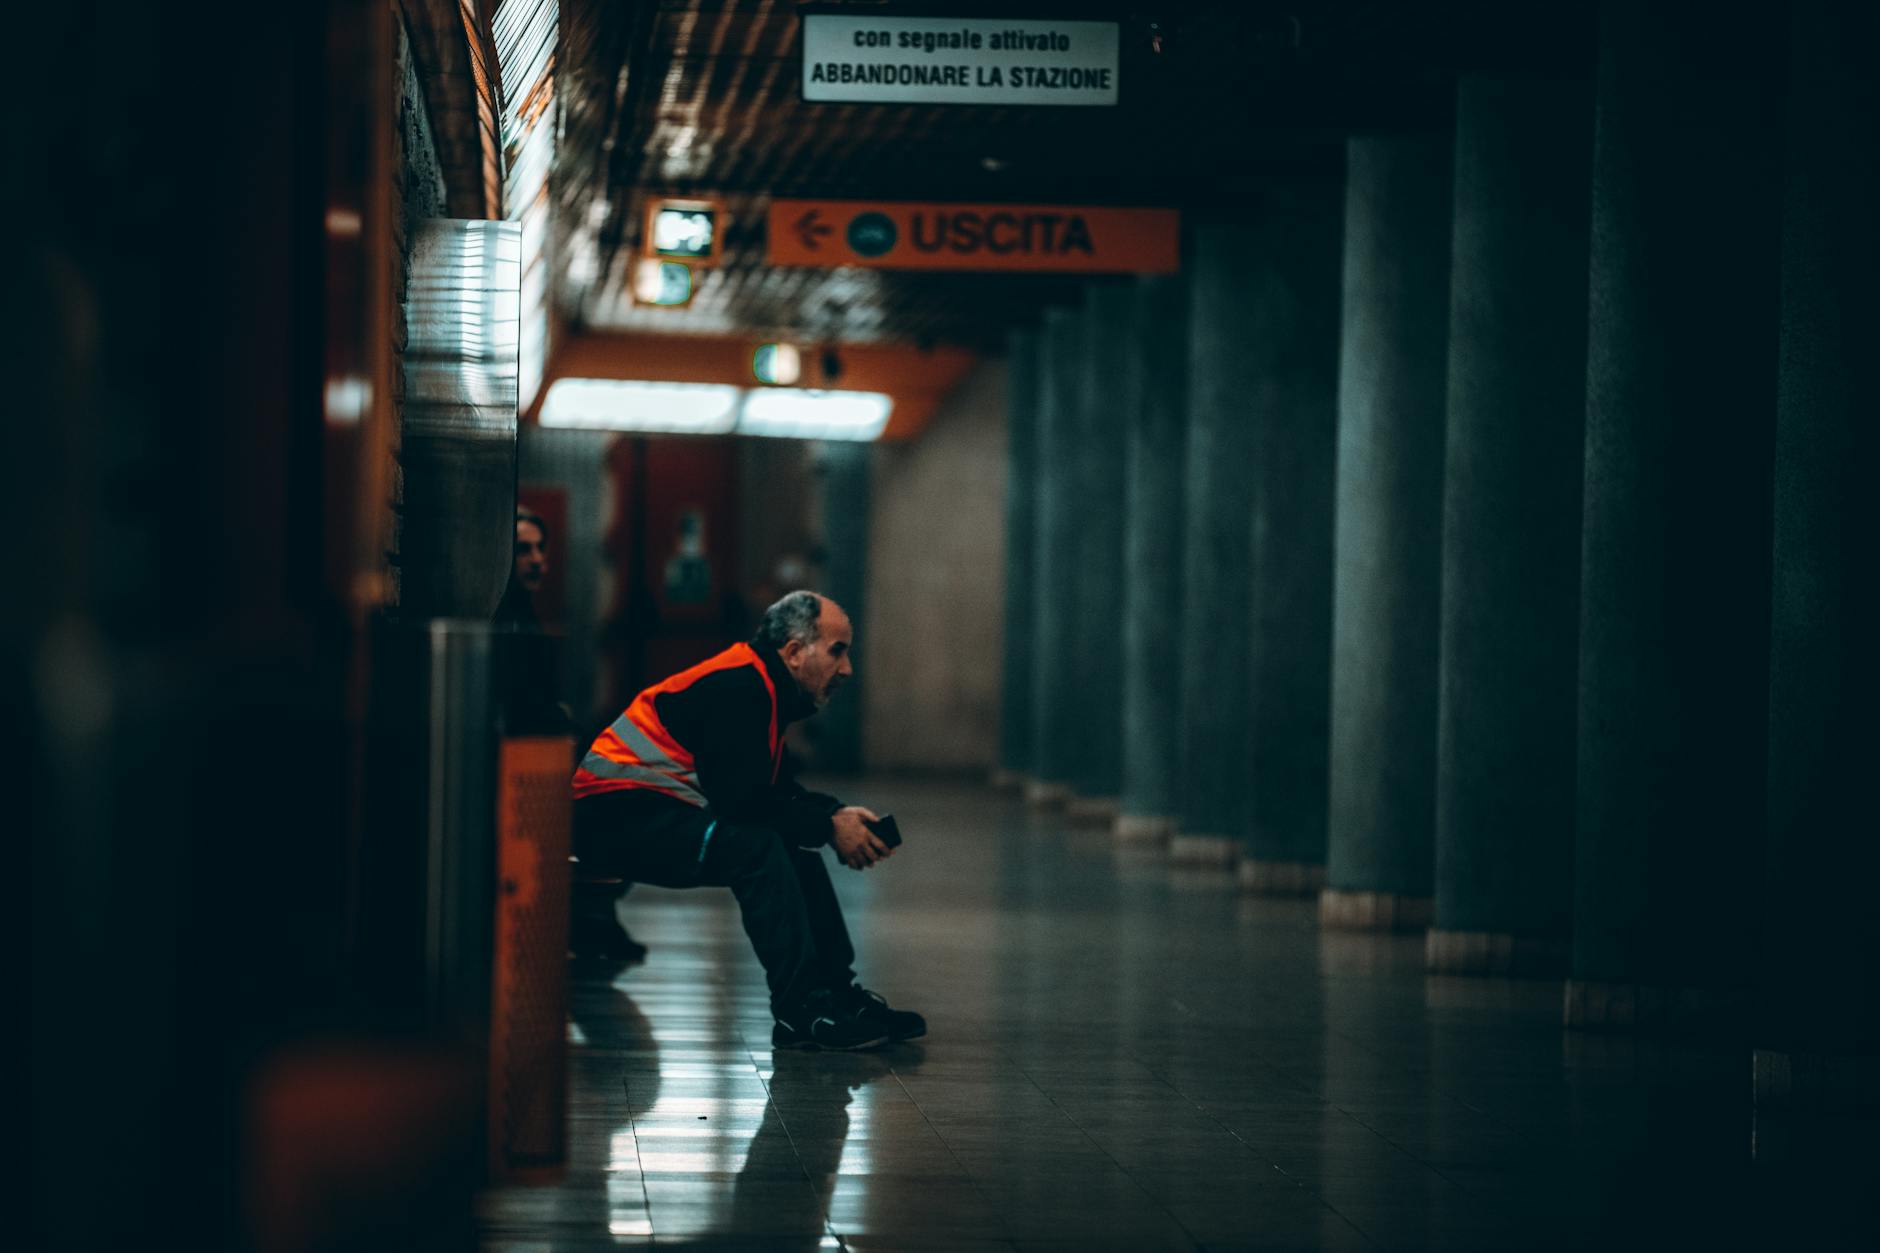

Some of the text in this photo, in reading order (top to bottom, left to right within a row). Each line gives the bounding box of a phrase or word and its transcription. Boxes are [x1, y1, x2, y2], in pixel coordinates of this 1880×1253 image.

[853, 28, 1070, 53] con segnale attivato
[811, 62, 1112, 90] ABBANDONARE LA STAZIONE
[911, 211, 1095, 255] USCITA
